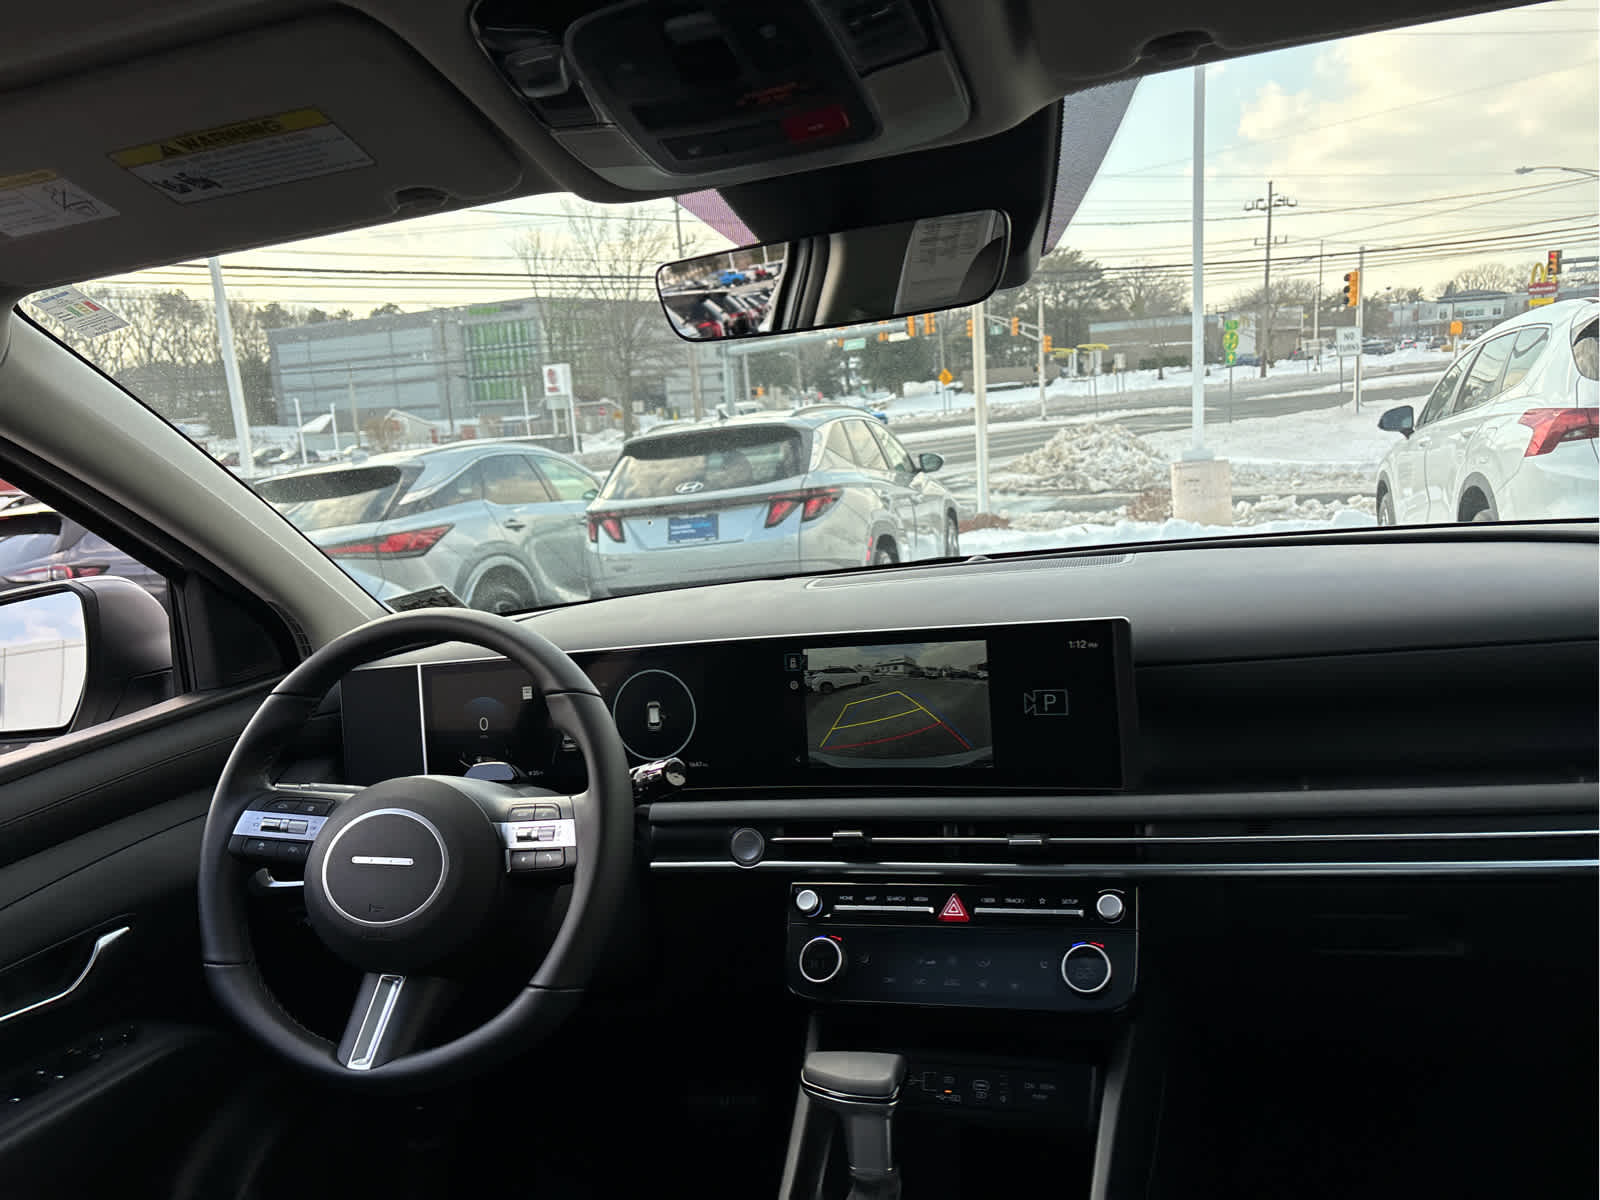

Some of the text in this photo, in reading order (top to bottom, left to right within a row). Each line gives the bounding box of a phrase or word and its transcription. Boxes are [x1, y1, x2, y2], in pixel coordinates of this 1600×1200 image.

[175, 119, 280, 152] WARNING
[1343, 331, 1355, 341] NO
[1337, 343, 1360, 352] TURNS
[1069, 640, 1087, 648] 1:12
